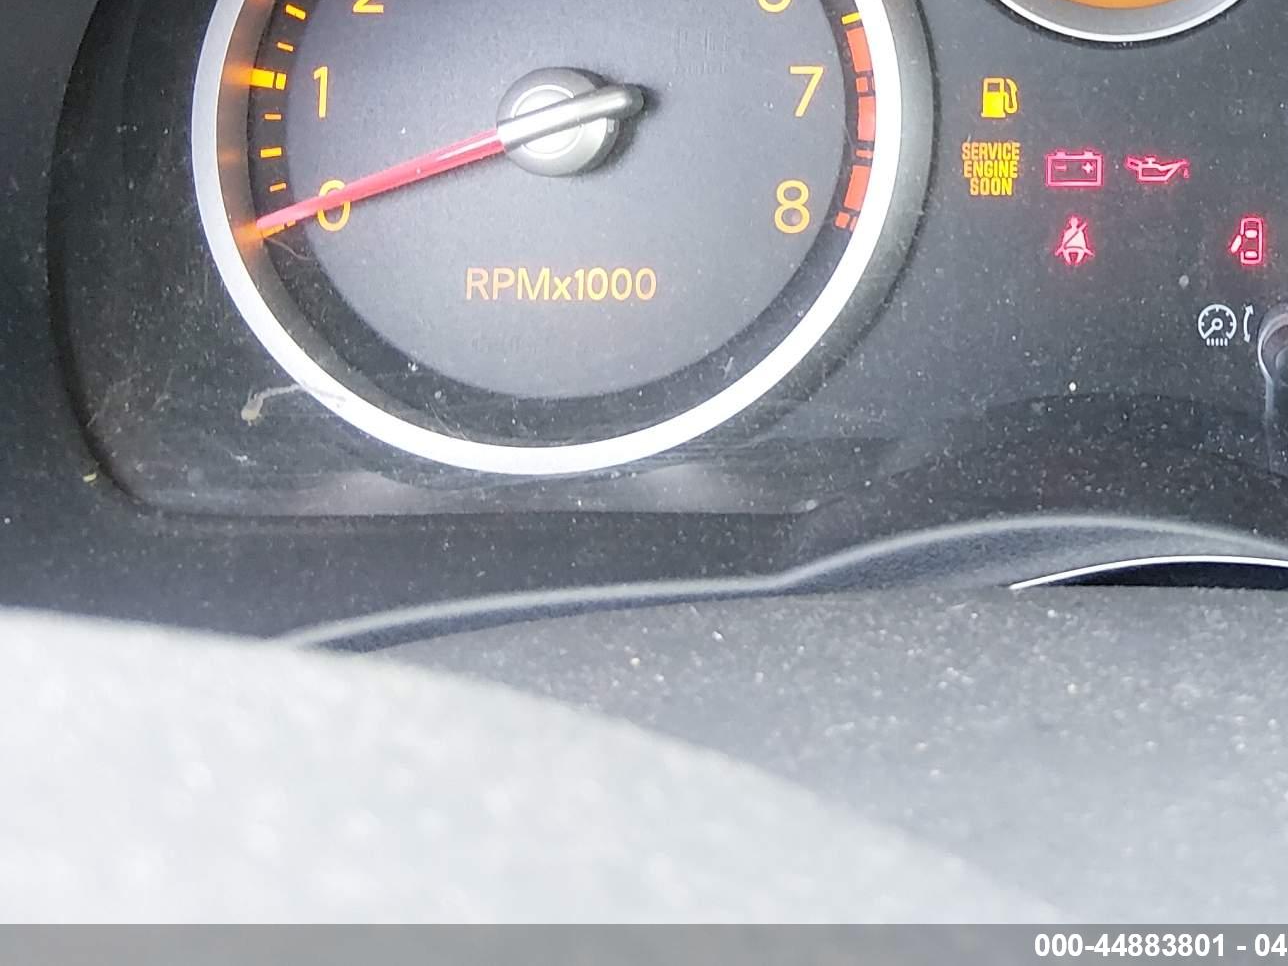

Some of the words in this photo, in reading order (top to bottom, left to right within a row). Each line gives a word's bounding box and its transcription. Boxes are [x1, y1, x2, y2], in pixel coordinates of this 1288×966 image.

[313, 66, 329, 119] 1
[790, 66, 824, 117] 7
[961, 142, 1020, 161] SERVICE
[963, 161, 1018, 178] ENGINE
[970, 177, 1013, 196] SOON
[775, 181, 810, 234] 8
[466, 266, 657, 301] RPMx1000
